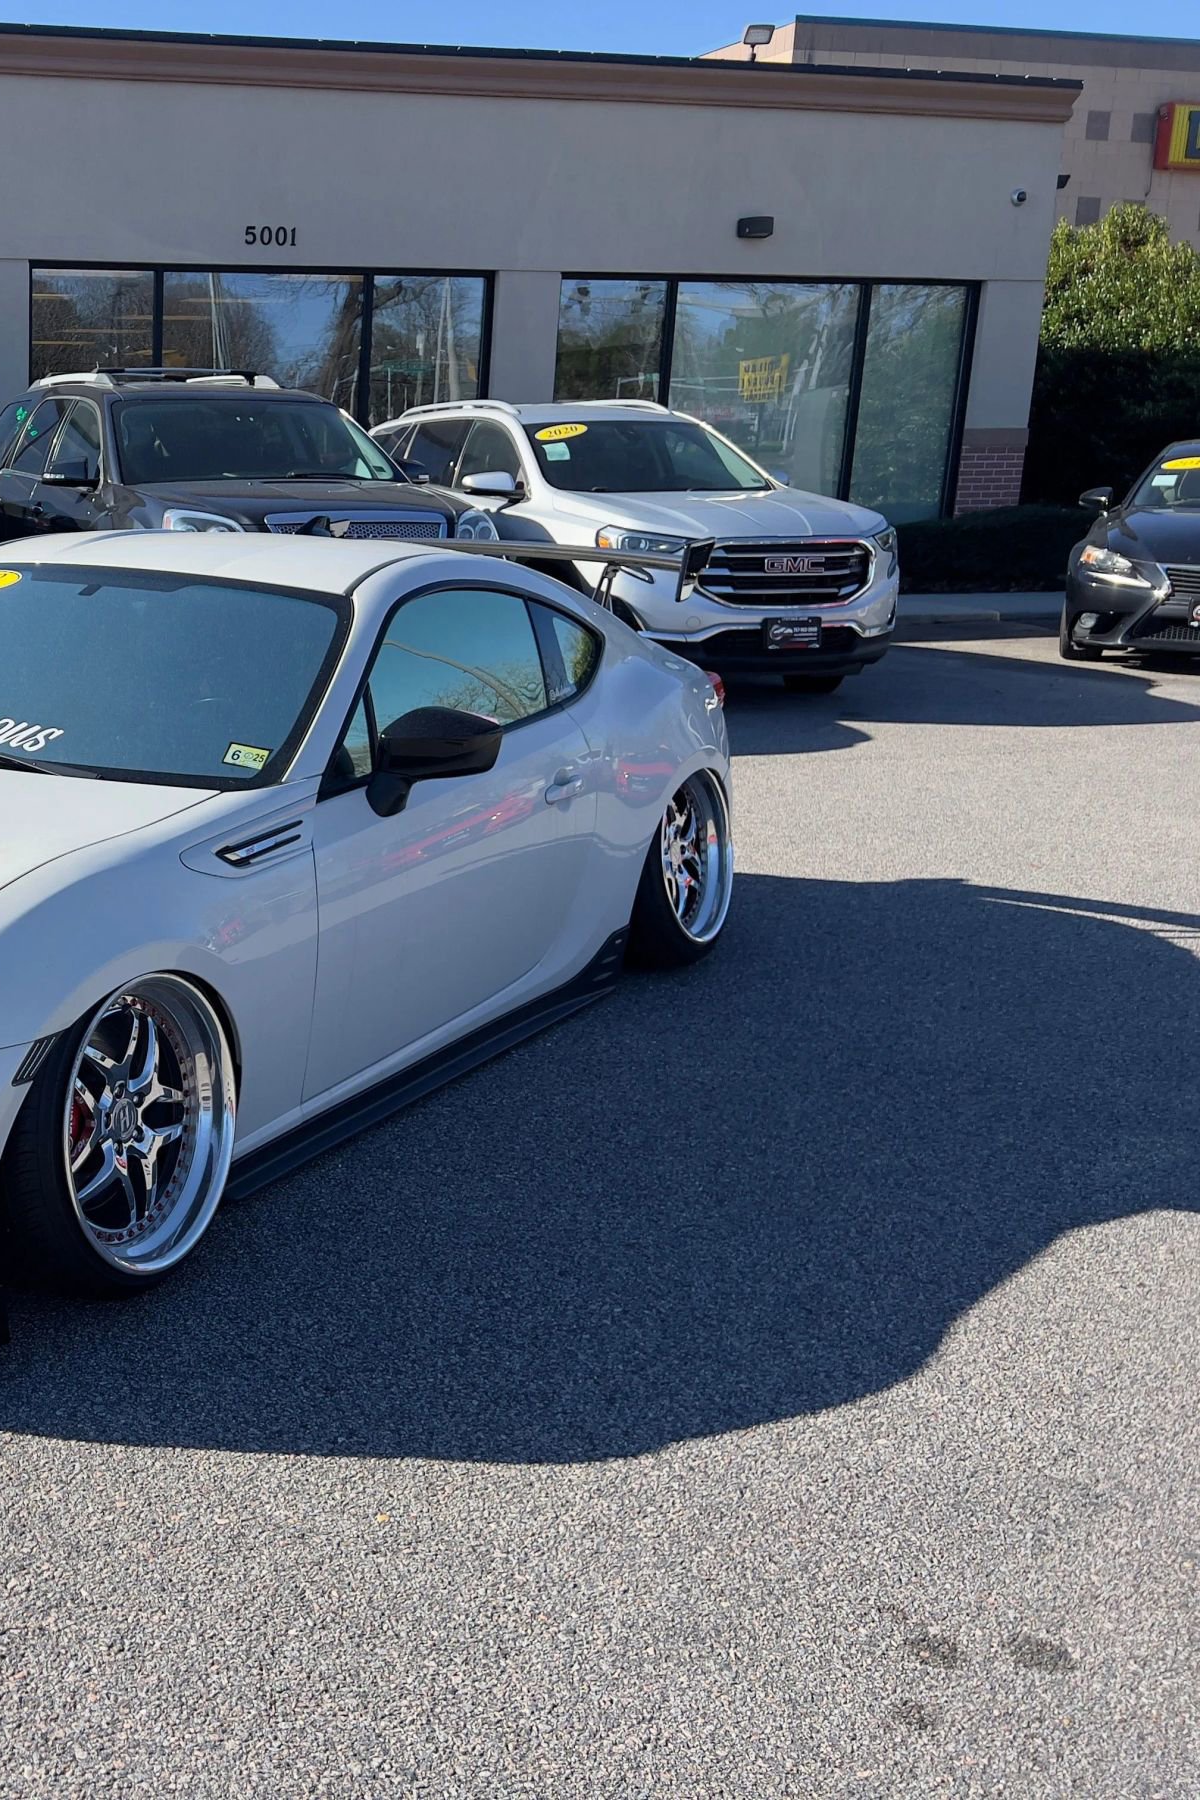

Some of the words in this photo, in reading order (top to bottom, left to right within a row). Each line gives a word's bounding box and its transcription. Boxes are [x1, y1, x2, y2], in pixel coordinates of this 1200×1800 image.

[244, 225, 297, 247] 5001
[547, 425, 578, 438] 2020
[765, 557, 825, 573] GMC
[231, 749, 242, 761] 6
[252, 753, 266, 763] 25
